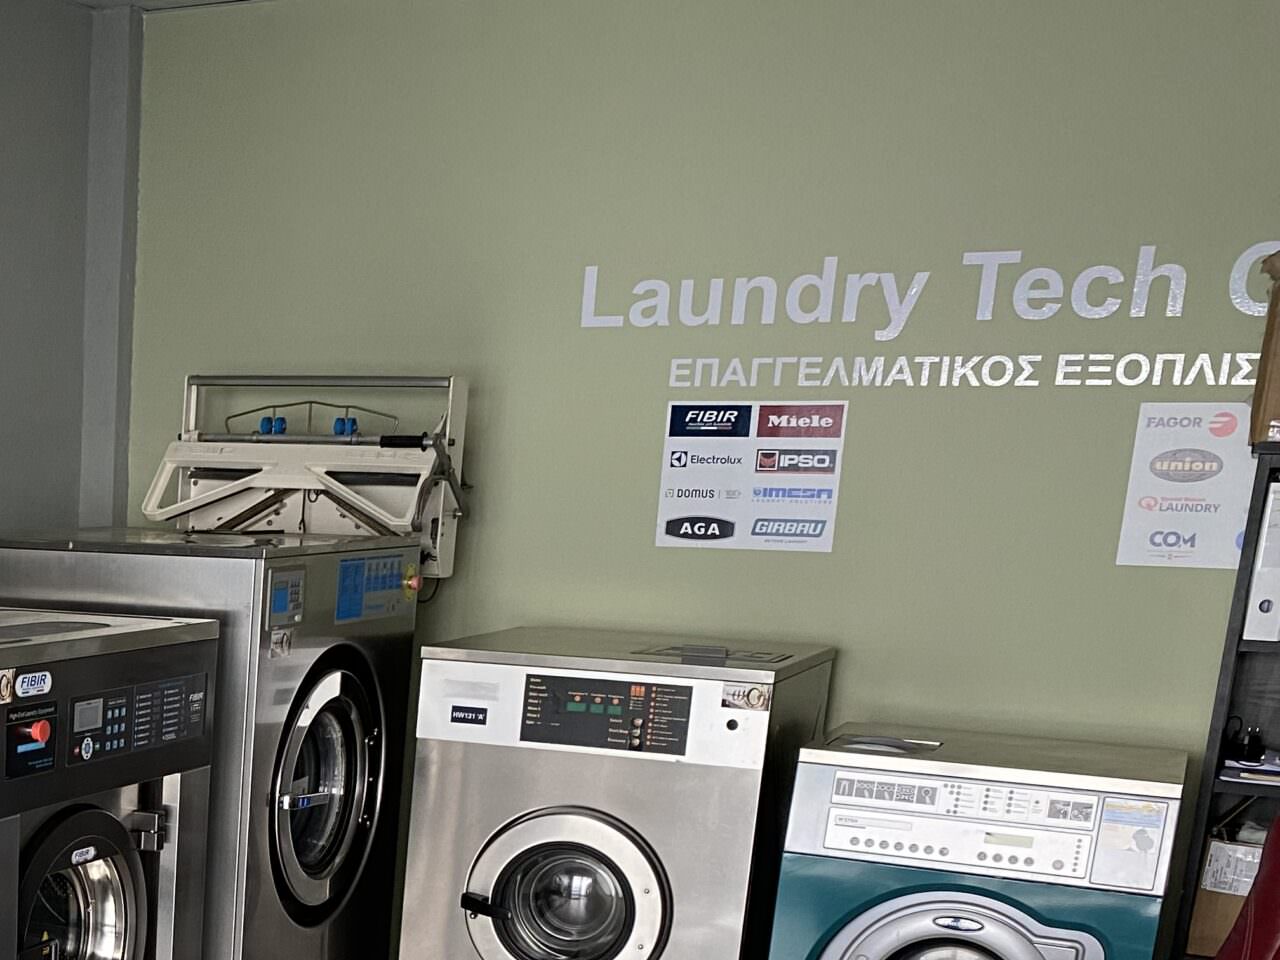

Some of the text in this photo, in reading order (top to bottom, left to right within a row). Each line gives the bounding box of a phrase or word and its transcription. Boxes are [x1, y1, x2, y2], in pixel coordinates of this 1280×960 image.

[580, 256, 930, 341] Laundry
[962, 245, 1187, 320] Tech
[669, 355, 1042, 388] ΕΠΑΓΓΕΛΜΑΤΙΚΟΣ
[685, 410, 738, 422] FIBIR
[767, 414, 833, 428] Miele
[1146, 416, 1203, 428] FAGOR
[690, 454, 742, 465] Electrolux
[779, 454, 830, 468] IPSO
[1154, 457, 1218, 472] union
[1159, 503, 1221, 513] LAUNDRY
[680, 522, 720, 536] AGA
[754, 520, 823, 536] GIRBAU
[20, 674, 47, 688] FIBIR
